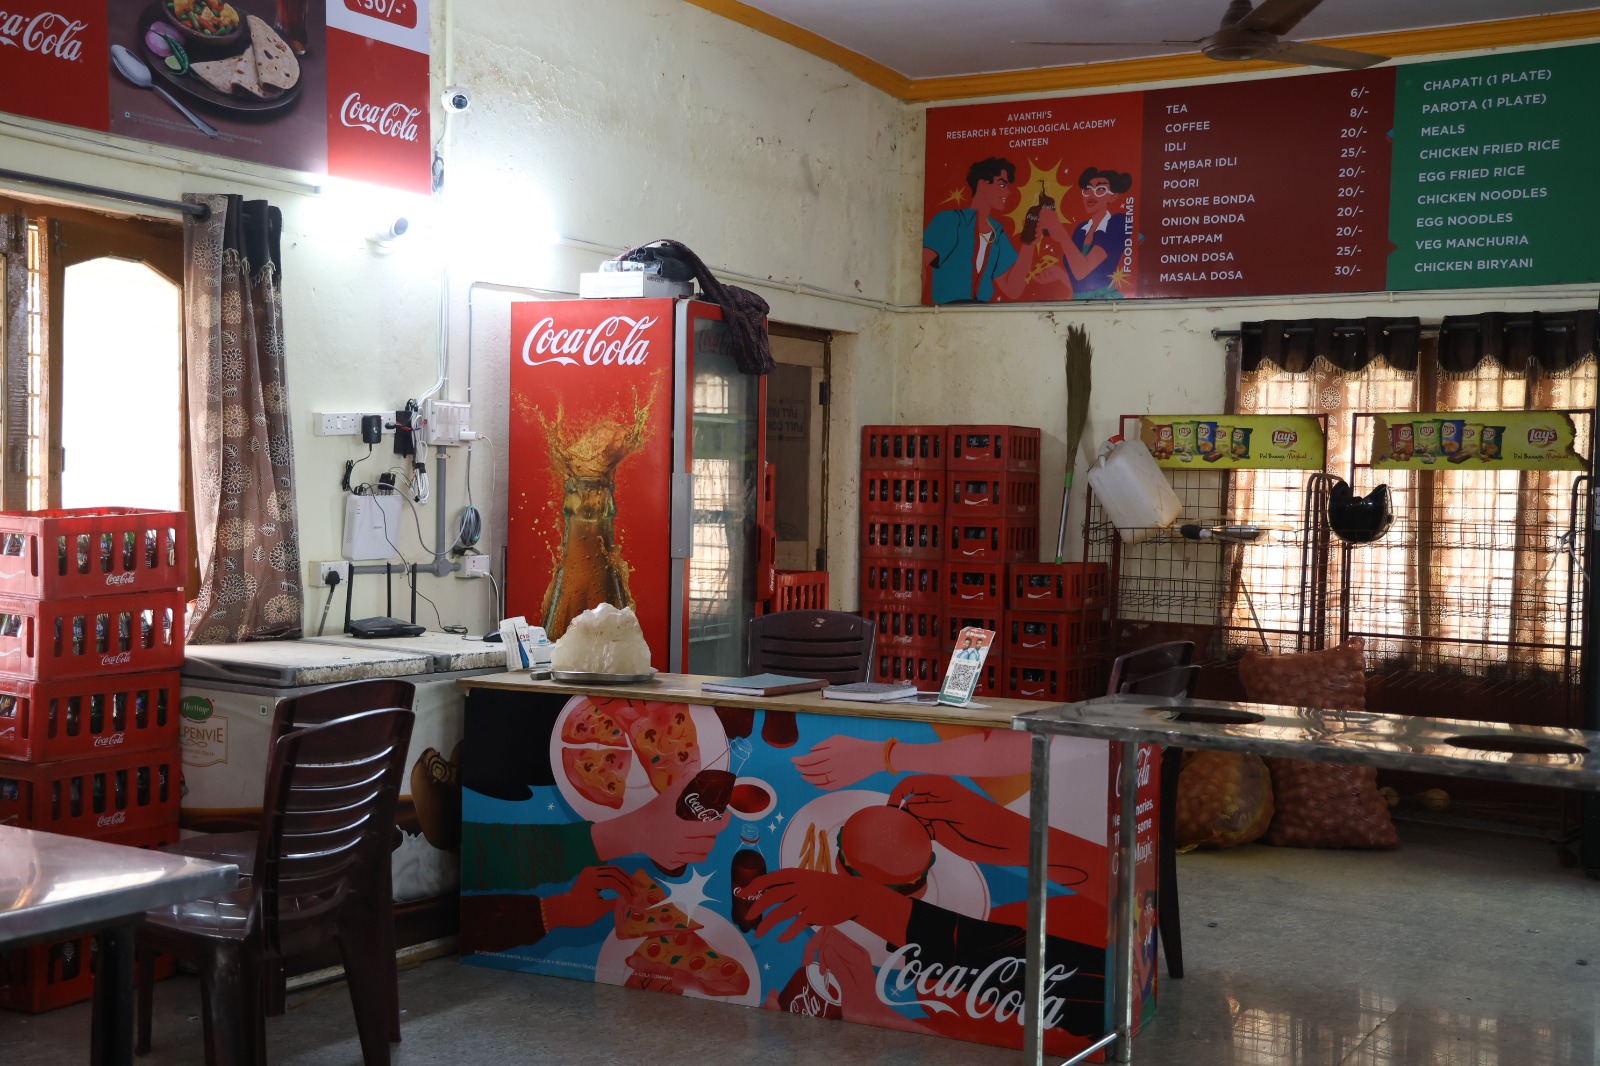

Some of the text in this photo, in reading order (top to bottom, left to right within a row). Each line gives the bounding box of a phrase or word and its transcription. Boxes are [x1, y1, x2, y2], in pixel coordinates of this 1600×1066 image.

[1424, 70, 1551, 90] CHAPATI (1 PLATE)
[1351, 87, 1369, 98] 6/-
[1166, 104, 1187, 114] TEA
[1423, 94, 1546, 114] PAROTA (1 PLATE)
[341, 92, 422, 142] Coca-Cola
[1007, 111, 1052, 121] AVANTHI'S
[1350, 107, 1368, 118] 8/-
[947, 129, 989, 139] RESEARCH
[999, 123, 1070, 135] TECHNOLOGICAL
[1073, 119, 1115, 129] ACADEMY
[1166, 121, 1209, 132] COFFEE
[1421, 125, 1464, 136] MEALS
[1341, 127, 1367, 138] 20/-
[1009, 138, 1048, 147] CANTEEN
[1165, 142, 1185, 151] IDLI
[1341, 147, 1366, 158] 25/-
[1420, 140, 1560, 159] CHICKEN FRIED RICE
[1164, 157, 1236, 169] SAMBAR IDLI
[1339, 166, 1365, 177] 20/-
[1419, 166, 1525, 182] EGG FRIED RICE
[1164, 179, 1198, 189] POORI
[1338, 186, 1364, 197] 20/-
[1418, 188, 1547, 204] CHICKEN NOODLES
[1163, 194, 1255, 207] MYSORE BONDA
[1337, 206, 1363, 217] 20/-
[1162, 214, 1244, 226] ONION BONDA
[1417, 213, 1512, 227] EGG NOODLES
[1122, 197, 1134, 272] FOOD ITEMS
[1336, 226, 1362, 236] 20/-
[1162, 234, 1222, 245] UTTAPPAM
[1416, 235, 1528, 249] VEG MANCHURIA
[1337, 245, 1361, 256] 25/-
[1161, 252, 1234, 263] ONION DOSA
[1335, 265, 1360, 276] 30/-
[1415, 258, 1532, 272] CHICKEN BIRYANI
[1160, 271, 1242, 282] MASALA DOSA
[522, 316, 659, 367] Coca-Cola
[183, 701, 210, 715] Heritage
